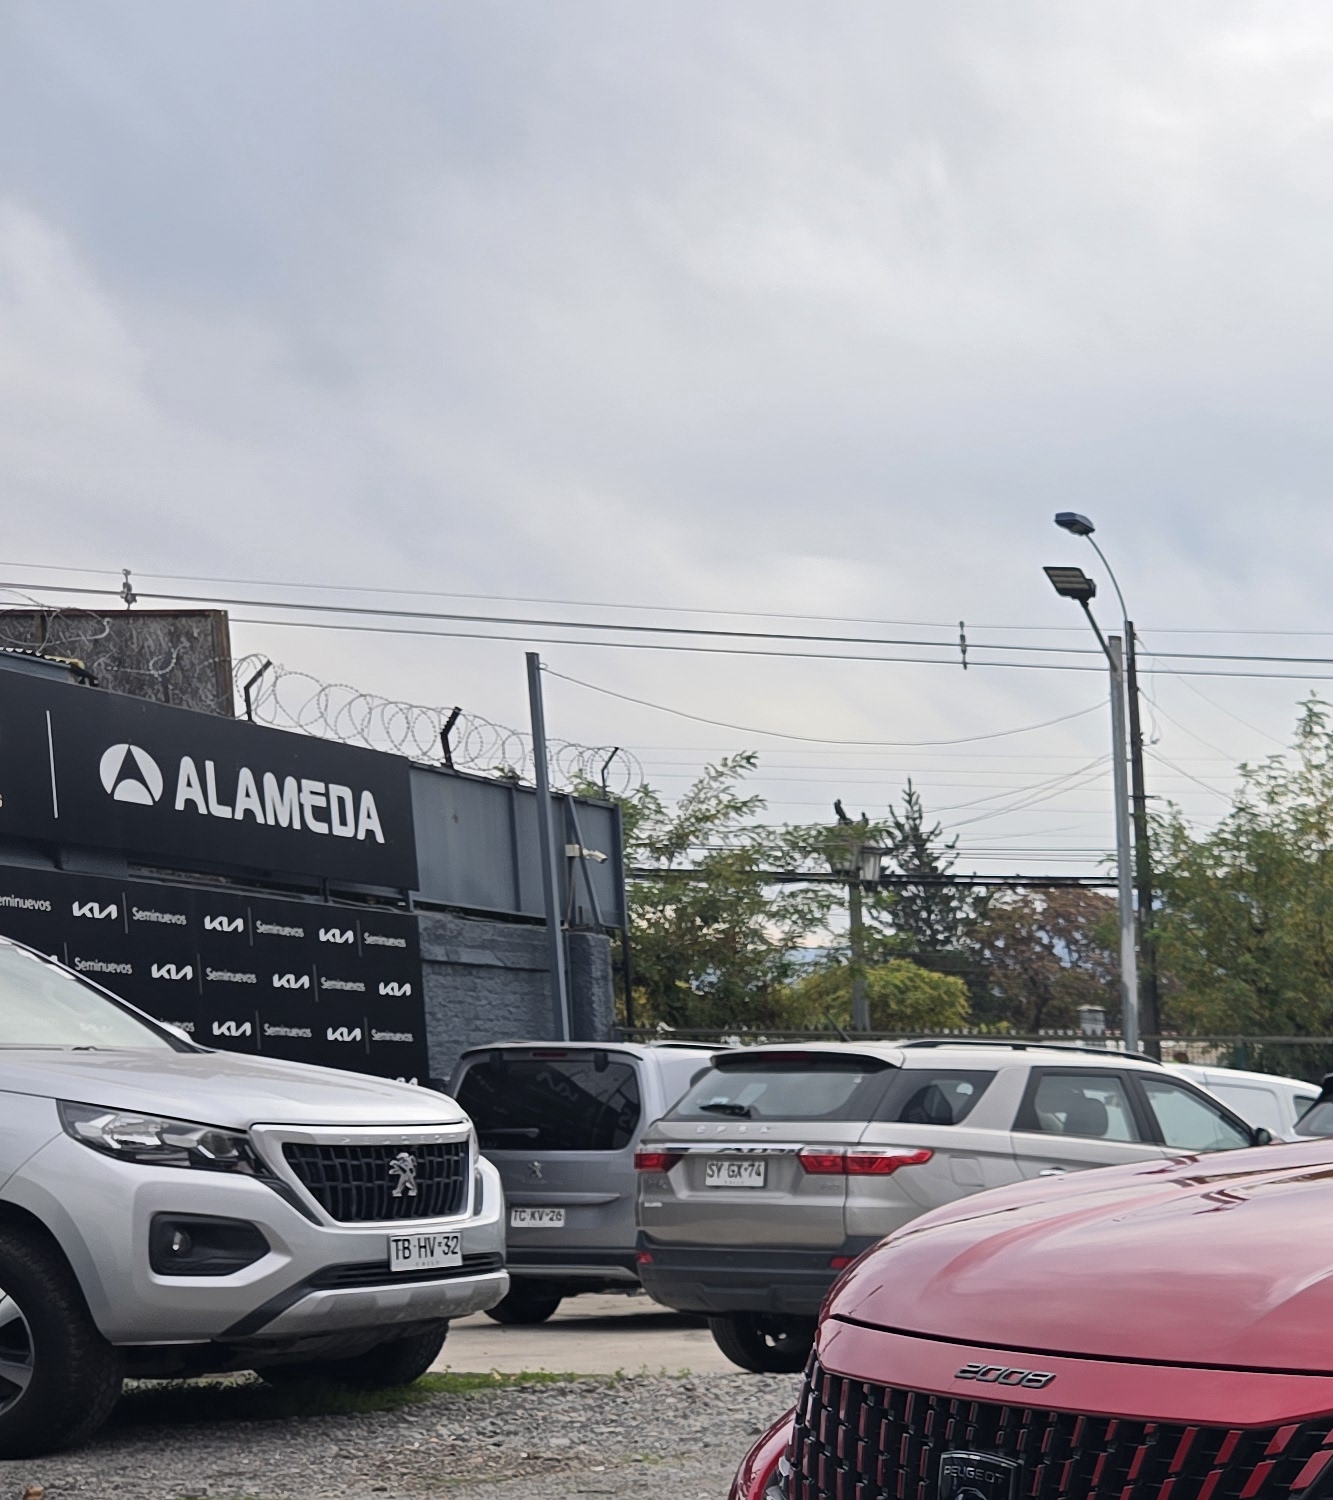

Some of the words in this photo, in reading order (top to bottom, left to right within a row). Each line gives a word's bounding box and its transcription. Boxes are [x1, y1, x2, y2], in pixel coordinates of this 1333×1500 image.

[175, 755, 385, 844] ALAMEDA
[72, 901, 118, 920] KIA
[132, 907, 187, 925] Seminuevos
[204, 915, 244, 932] KIA
[256, 920, 304, 937] Seminuevos
[319, 928, 354, 944] KIA
[364, 932, 406, 947] Seminuevos
[74, 957, 132, 975] Seminuevos
[151, 963, 193, 980] KIA
[206, 967, 257, 983] Seminuevos
[272, 973, 310, 989] KIA
[320, 976, 366, 992] Seminuevos
[378, 981, 412, 997] KIA
[212, 1021, 252, 1037] KIA
[263, 1023, 312, 1038] Seminuevos
[326, 1027, 362, 1041] KIA
[371, 1029, 414, 1042] Seminuevos
[954, 1362, 1057, 1390] 2008
[943, 1465, 1005, 1483] PEUGEOT
